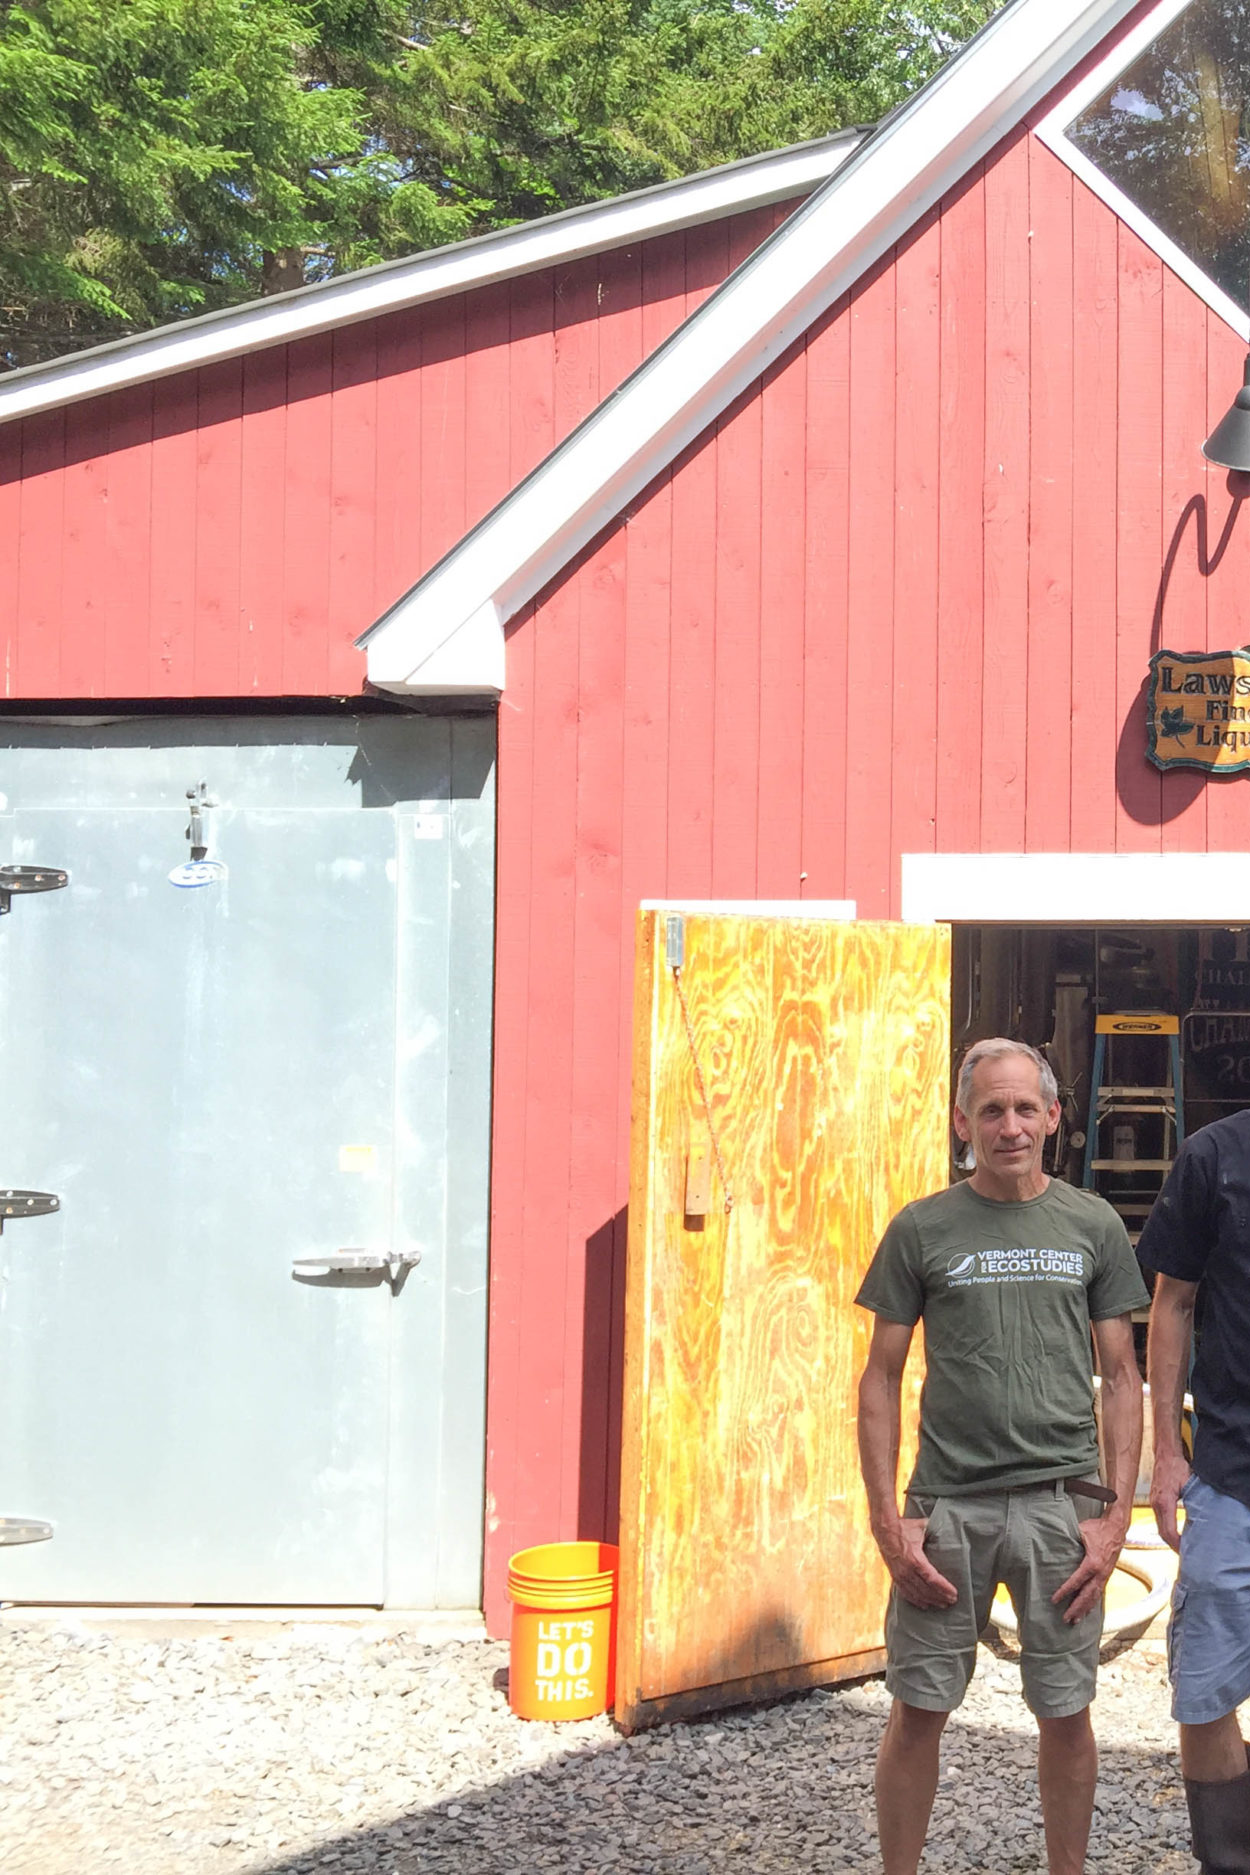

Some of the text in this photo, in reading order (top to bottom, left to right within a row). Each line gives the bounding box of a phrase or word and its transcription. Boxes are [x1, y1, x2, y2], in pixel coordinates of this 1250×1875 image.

[978, 1249, 1084, 1264] VERMONT CENTER
[988, 1259, 1084, 1276] ECOSTUDIES
[1010, 1274, 1034, 1282] Science
[1034, 1273, 1045, 1281] for
[538, 1620, 595, 1641] LET'S
[537, 1642, 592, 1678] DO
[535, 1678, 594, 1702] THIS.
